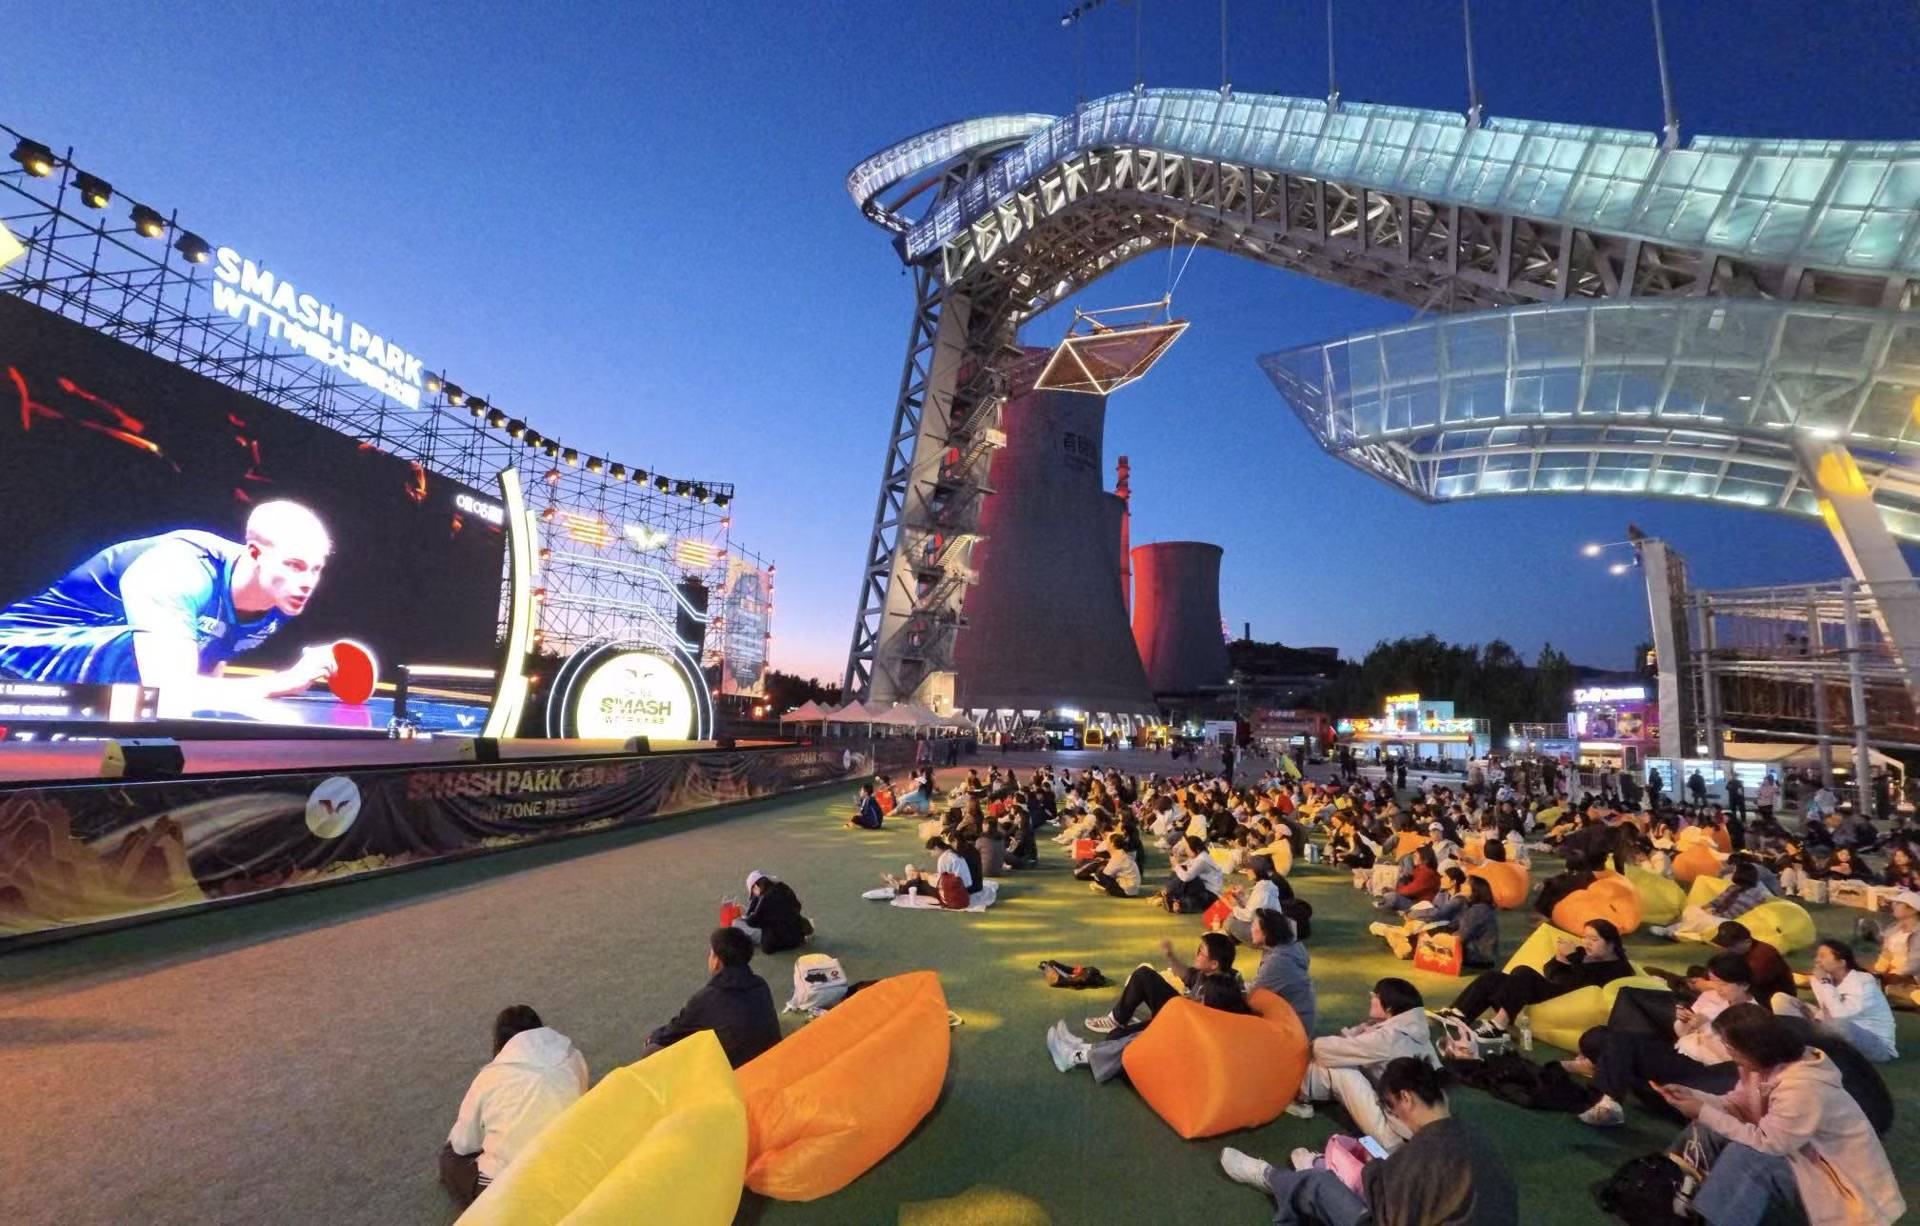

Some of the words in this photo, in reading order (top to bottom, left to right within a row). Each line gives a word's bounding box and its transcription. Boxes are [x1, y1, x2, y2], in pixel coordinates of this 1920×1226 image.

[214, 246, 344, 343] SMASH
[350, 321, 424, 387] PARK
[600, 697, 672, 716] SMASH
[410, 771, 502, 800] SMASH
[505, 767, 563, 793] PARK
[503, 800, 544, 819] ZONE
